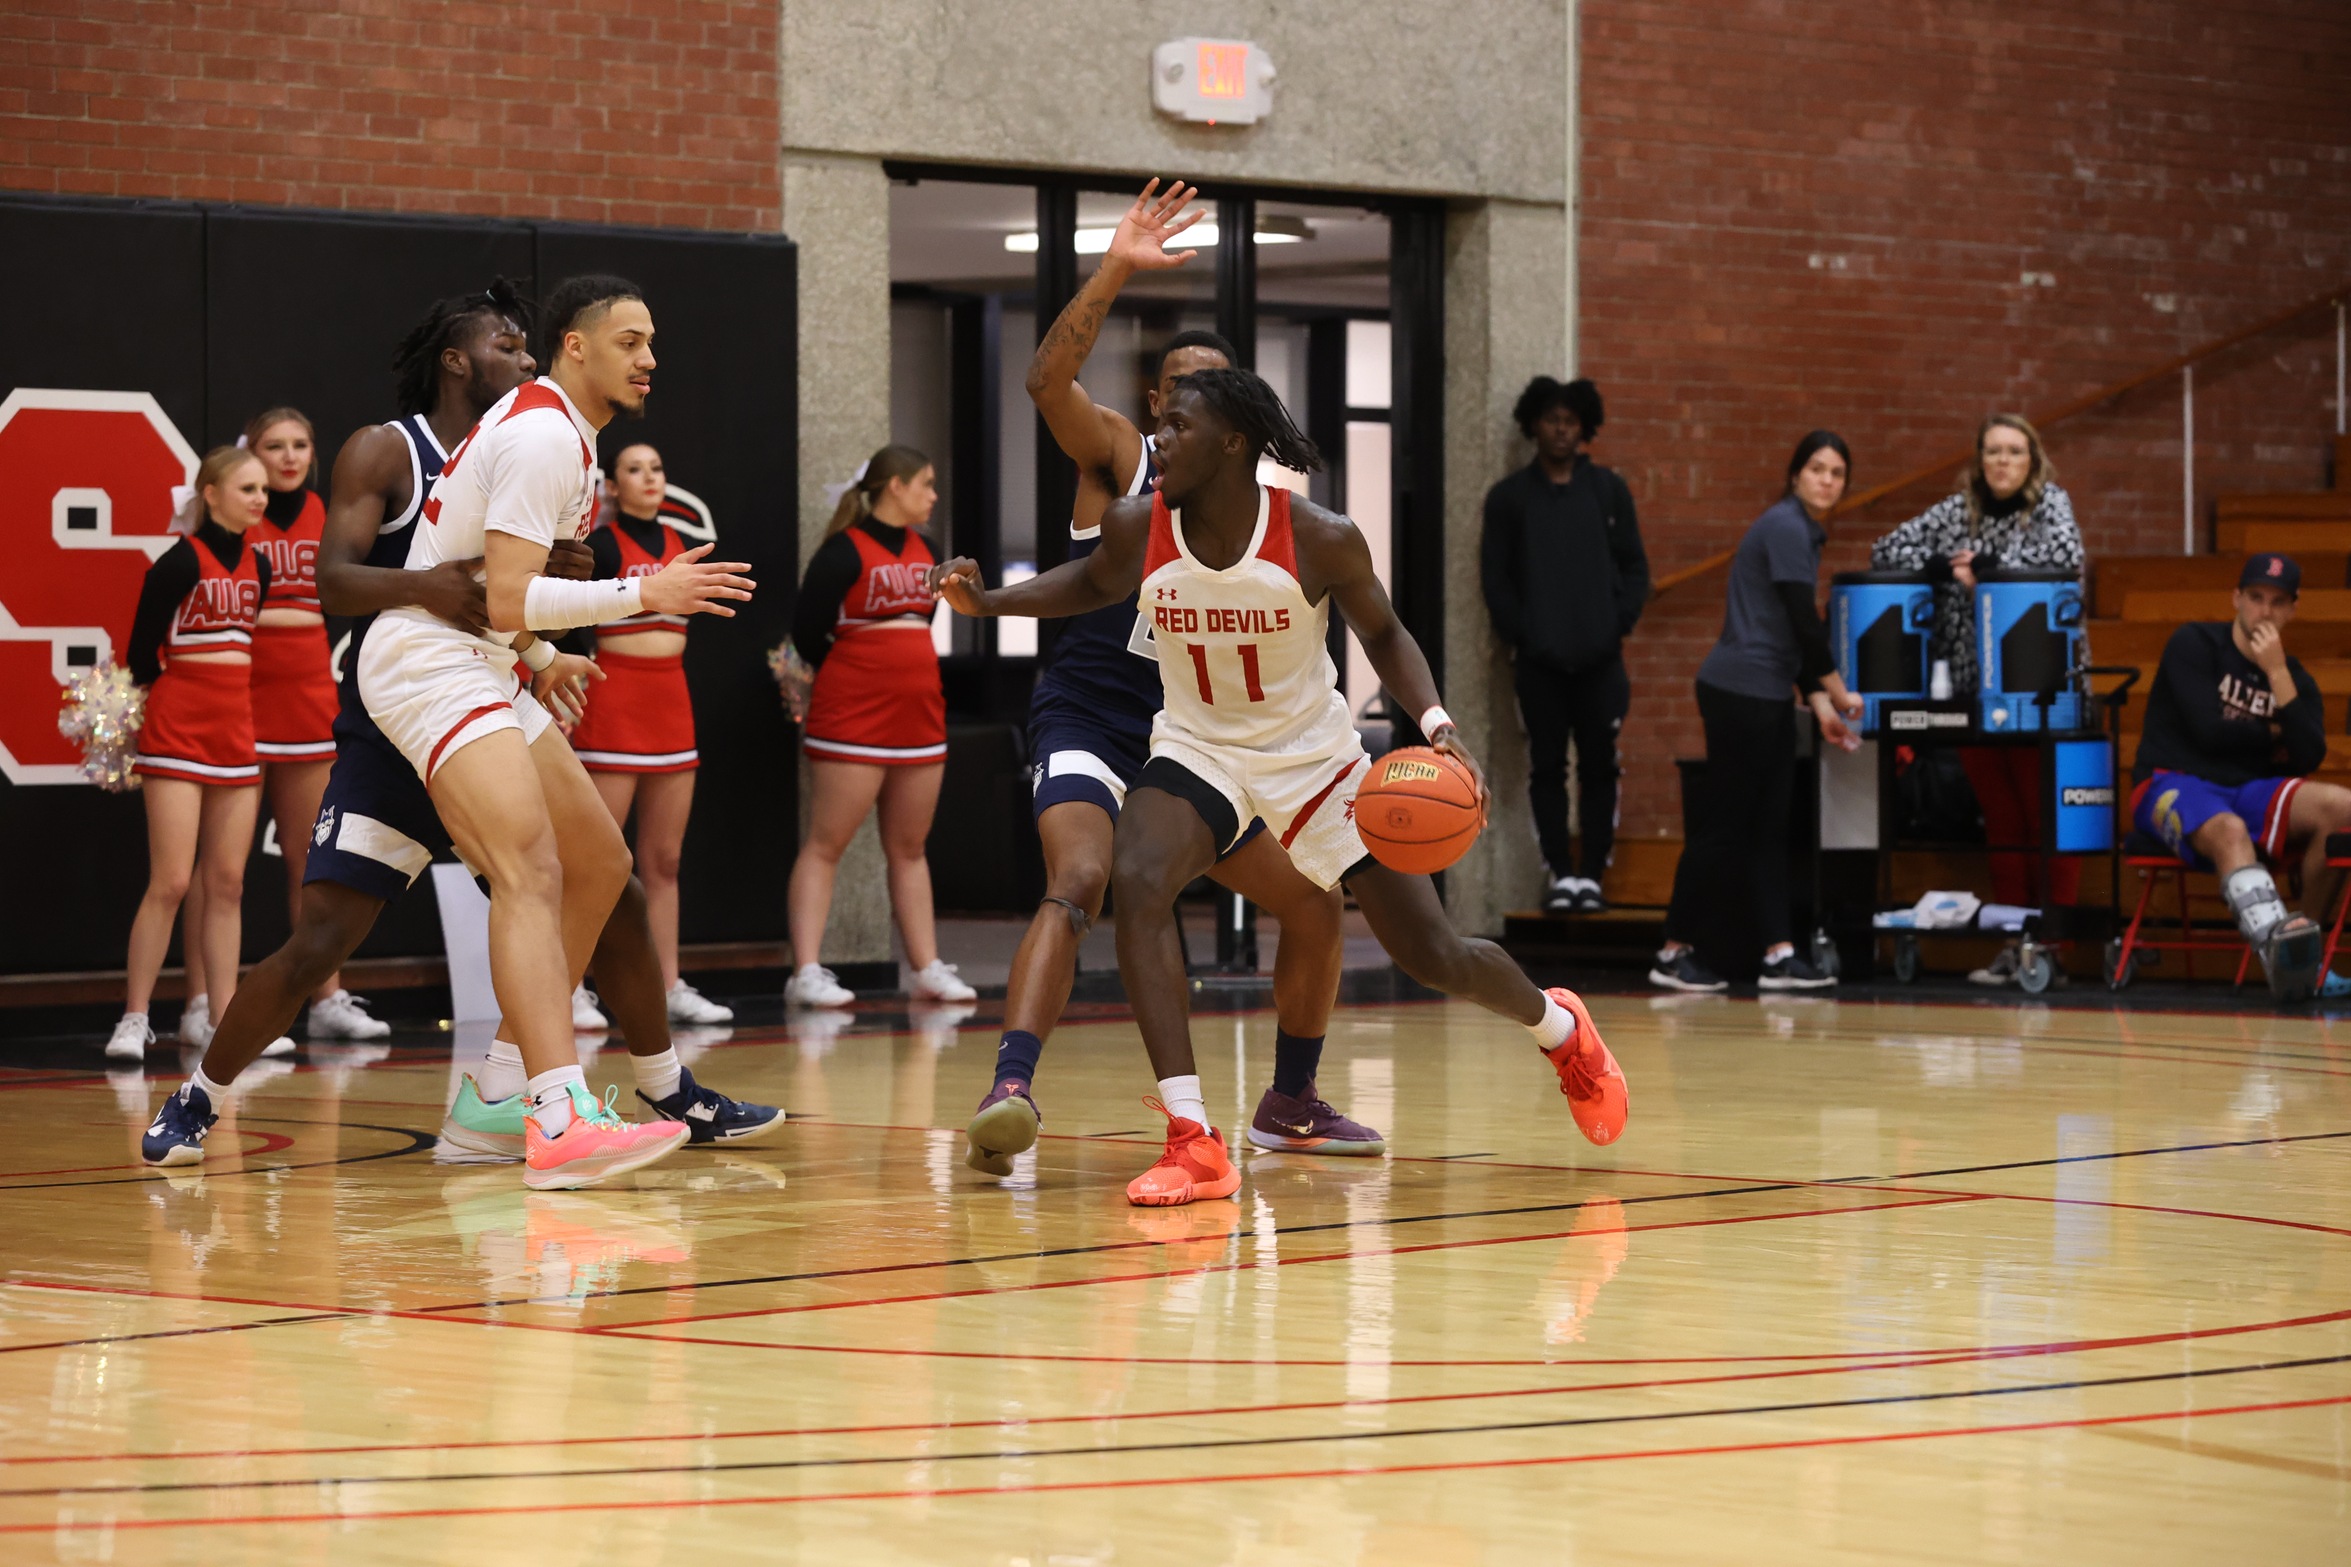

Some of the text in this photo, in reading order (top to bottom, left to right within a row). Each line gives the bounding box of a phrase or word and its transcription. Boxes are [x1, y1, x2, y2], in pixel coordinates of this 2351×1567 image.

[1197, 43, 1248, 99] EXIT
[2266, 557, 2284, 577] B
[1154, 606, 1290, 634] RED DEVILS
[1187, 643, 1265, 706] 11
